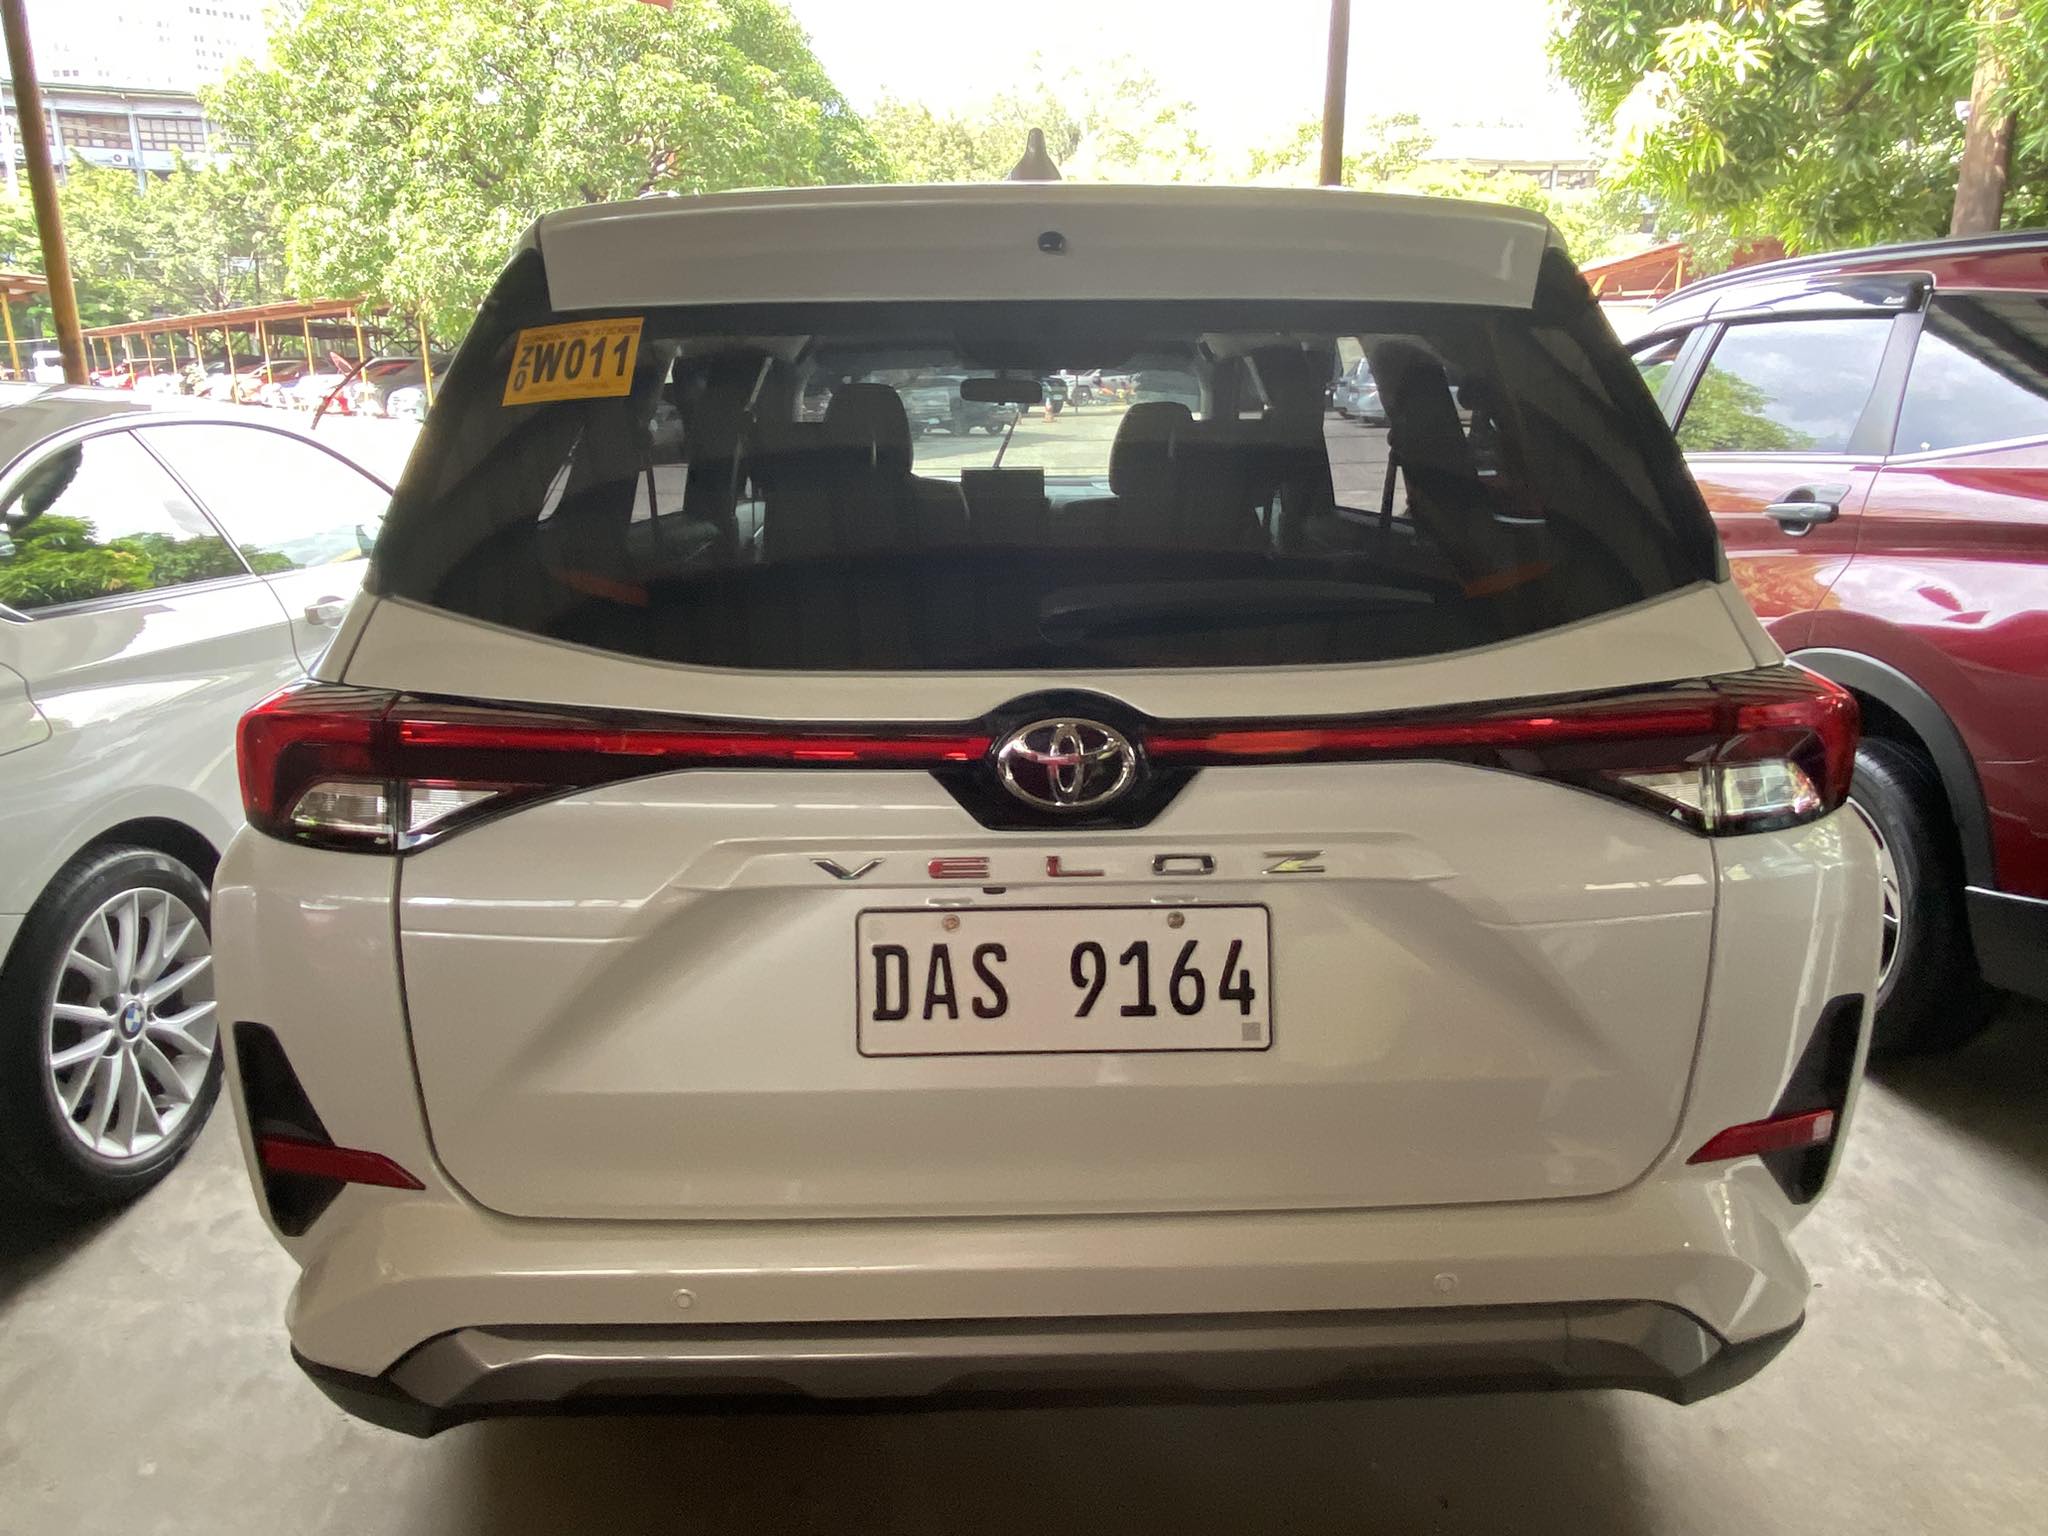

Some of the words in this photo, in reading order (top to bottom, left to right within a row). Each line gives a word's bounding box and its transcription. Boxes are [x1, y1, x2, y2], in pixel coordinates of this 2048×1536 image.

[809, 850, 1326, 880] VELOZ
[872, 942, 1008, 1021] DAS
[1070, 939, 1255, 1018] 9164
